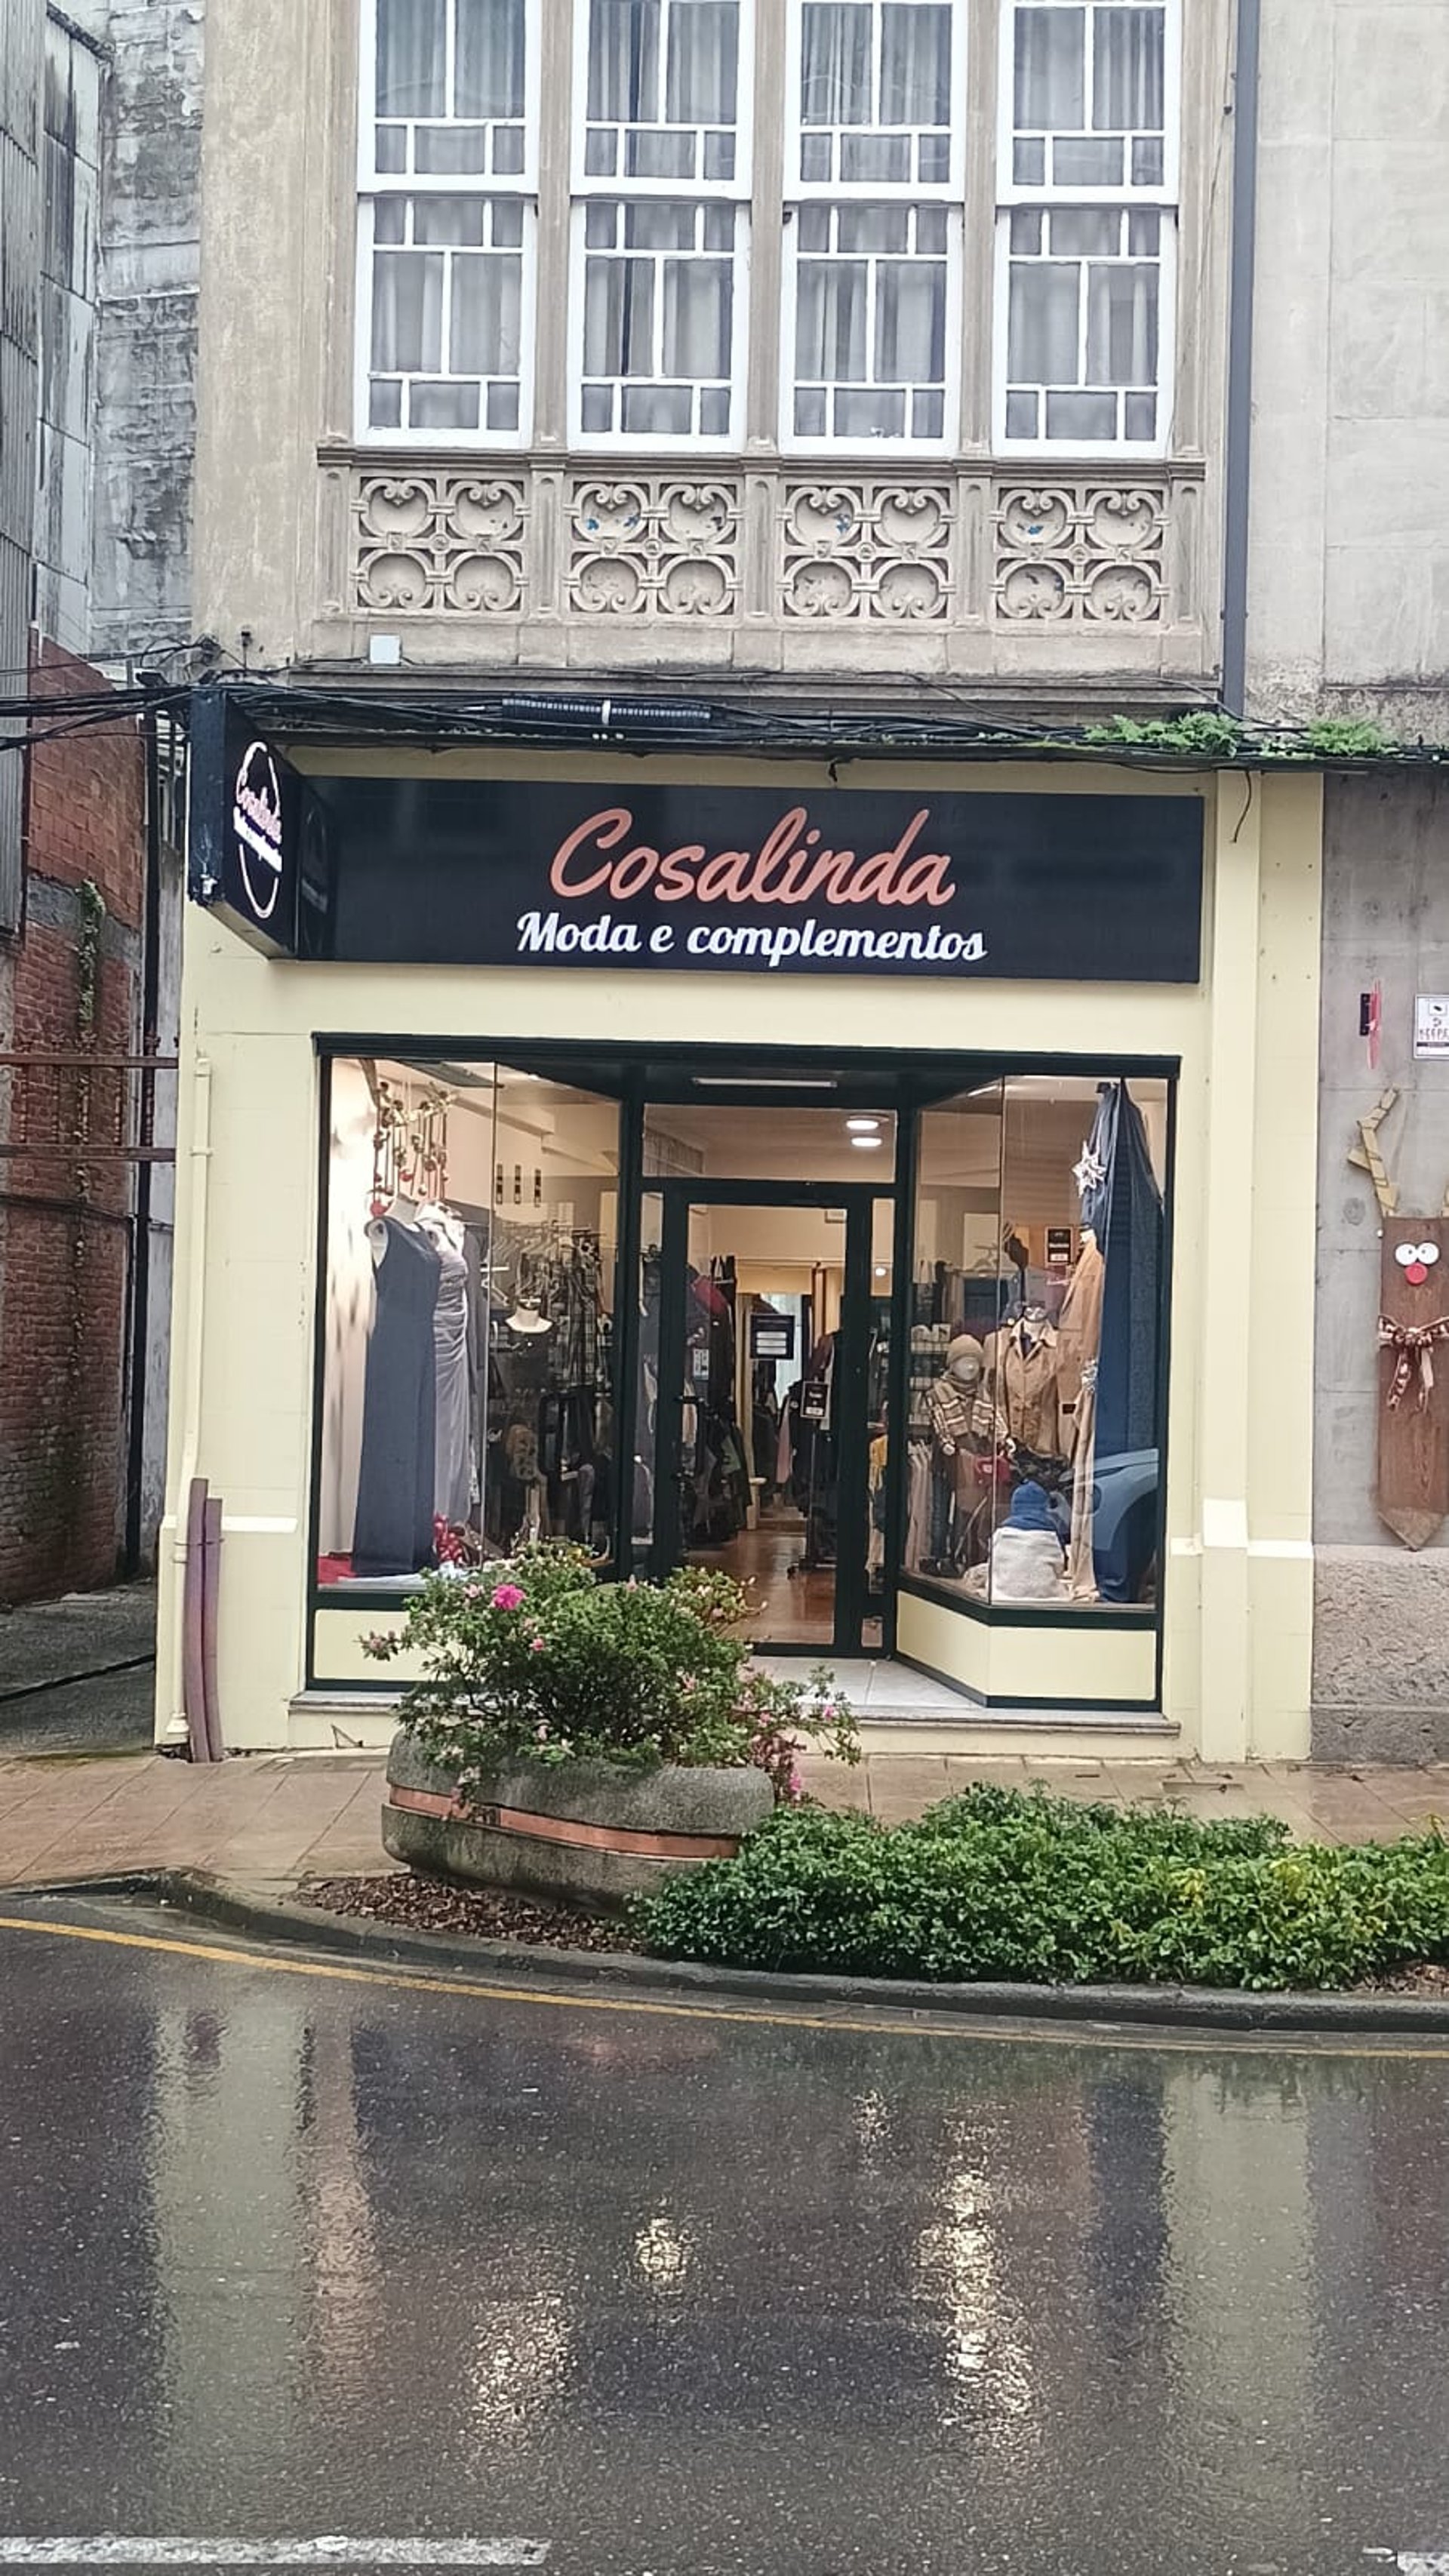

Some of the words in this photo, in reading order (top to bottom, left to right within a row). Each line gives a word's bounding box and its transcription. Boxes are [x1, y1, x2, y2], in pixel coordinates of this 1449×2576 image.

[549, 807, 956, 906] Cosalinda
[516, 911, 641, 953] Moda
[650, 925, 675, 953] e
[686, 919, 988, 968] complementos
